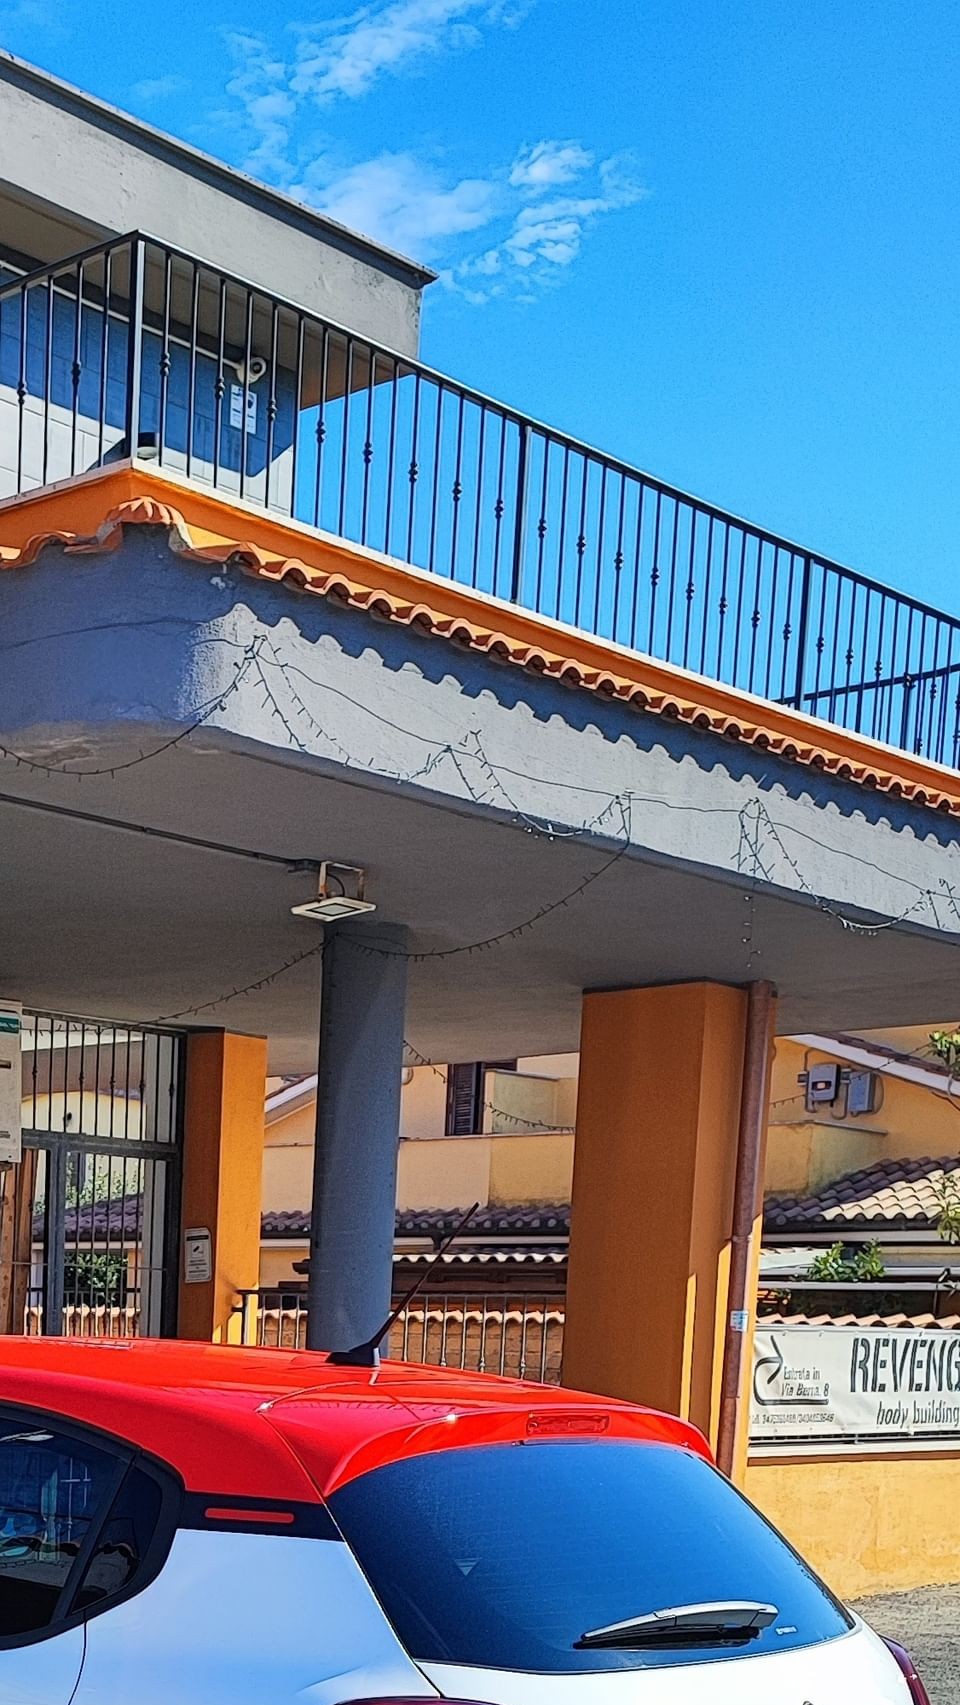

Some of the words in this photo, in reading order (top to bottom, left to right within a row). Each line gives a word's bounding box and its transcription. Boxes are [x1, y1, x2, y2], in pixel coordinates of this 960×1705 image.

[812, 1366, 821, 1380] in
[781, 1383, 794, 1397] Via
[823, 1383, 829, 1397] 8
[876, 1400, 909, 1429] body
[912, 1399, 960, 1428] building
